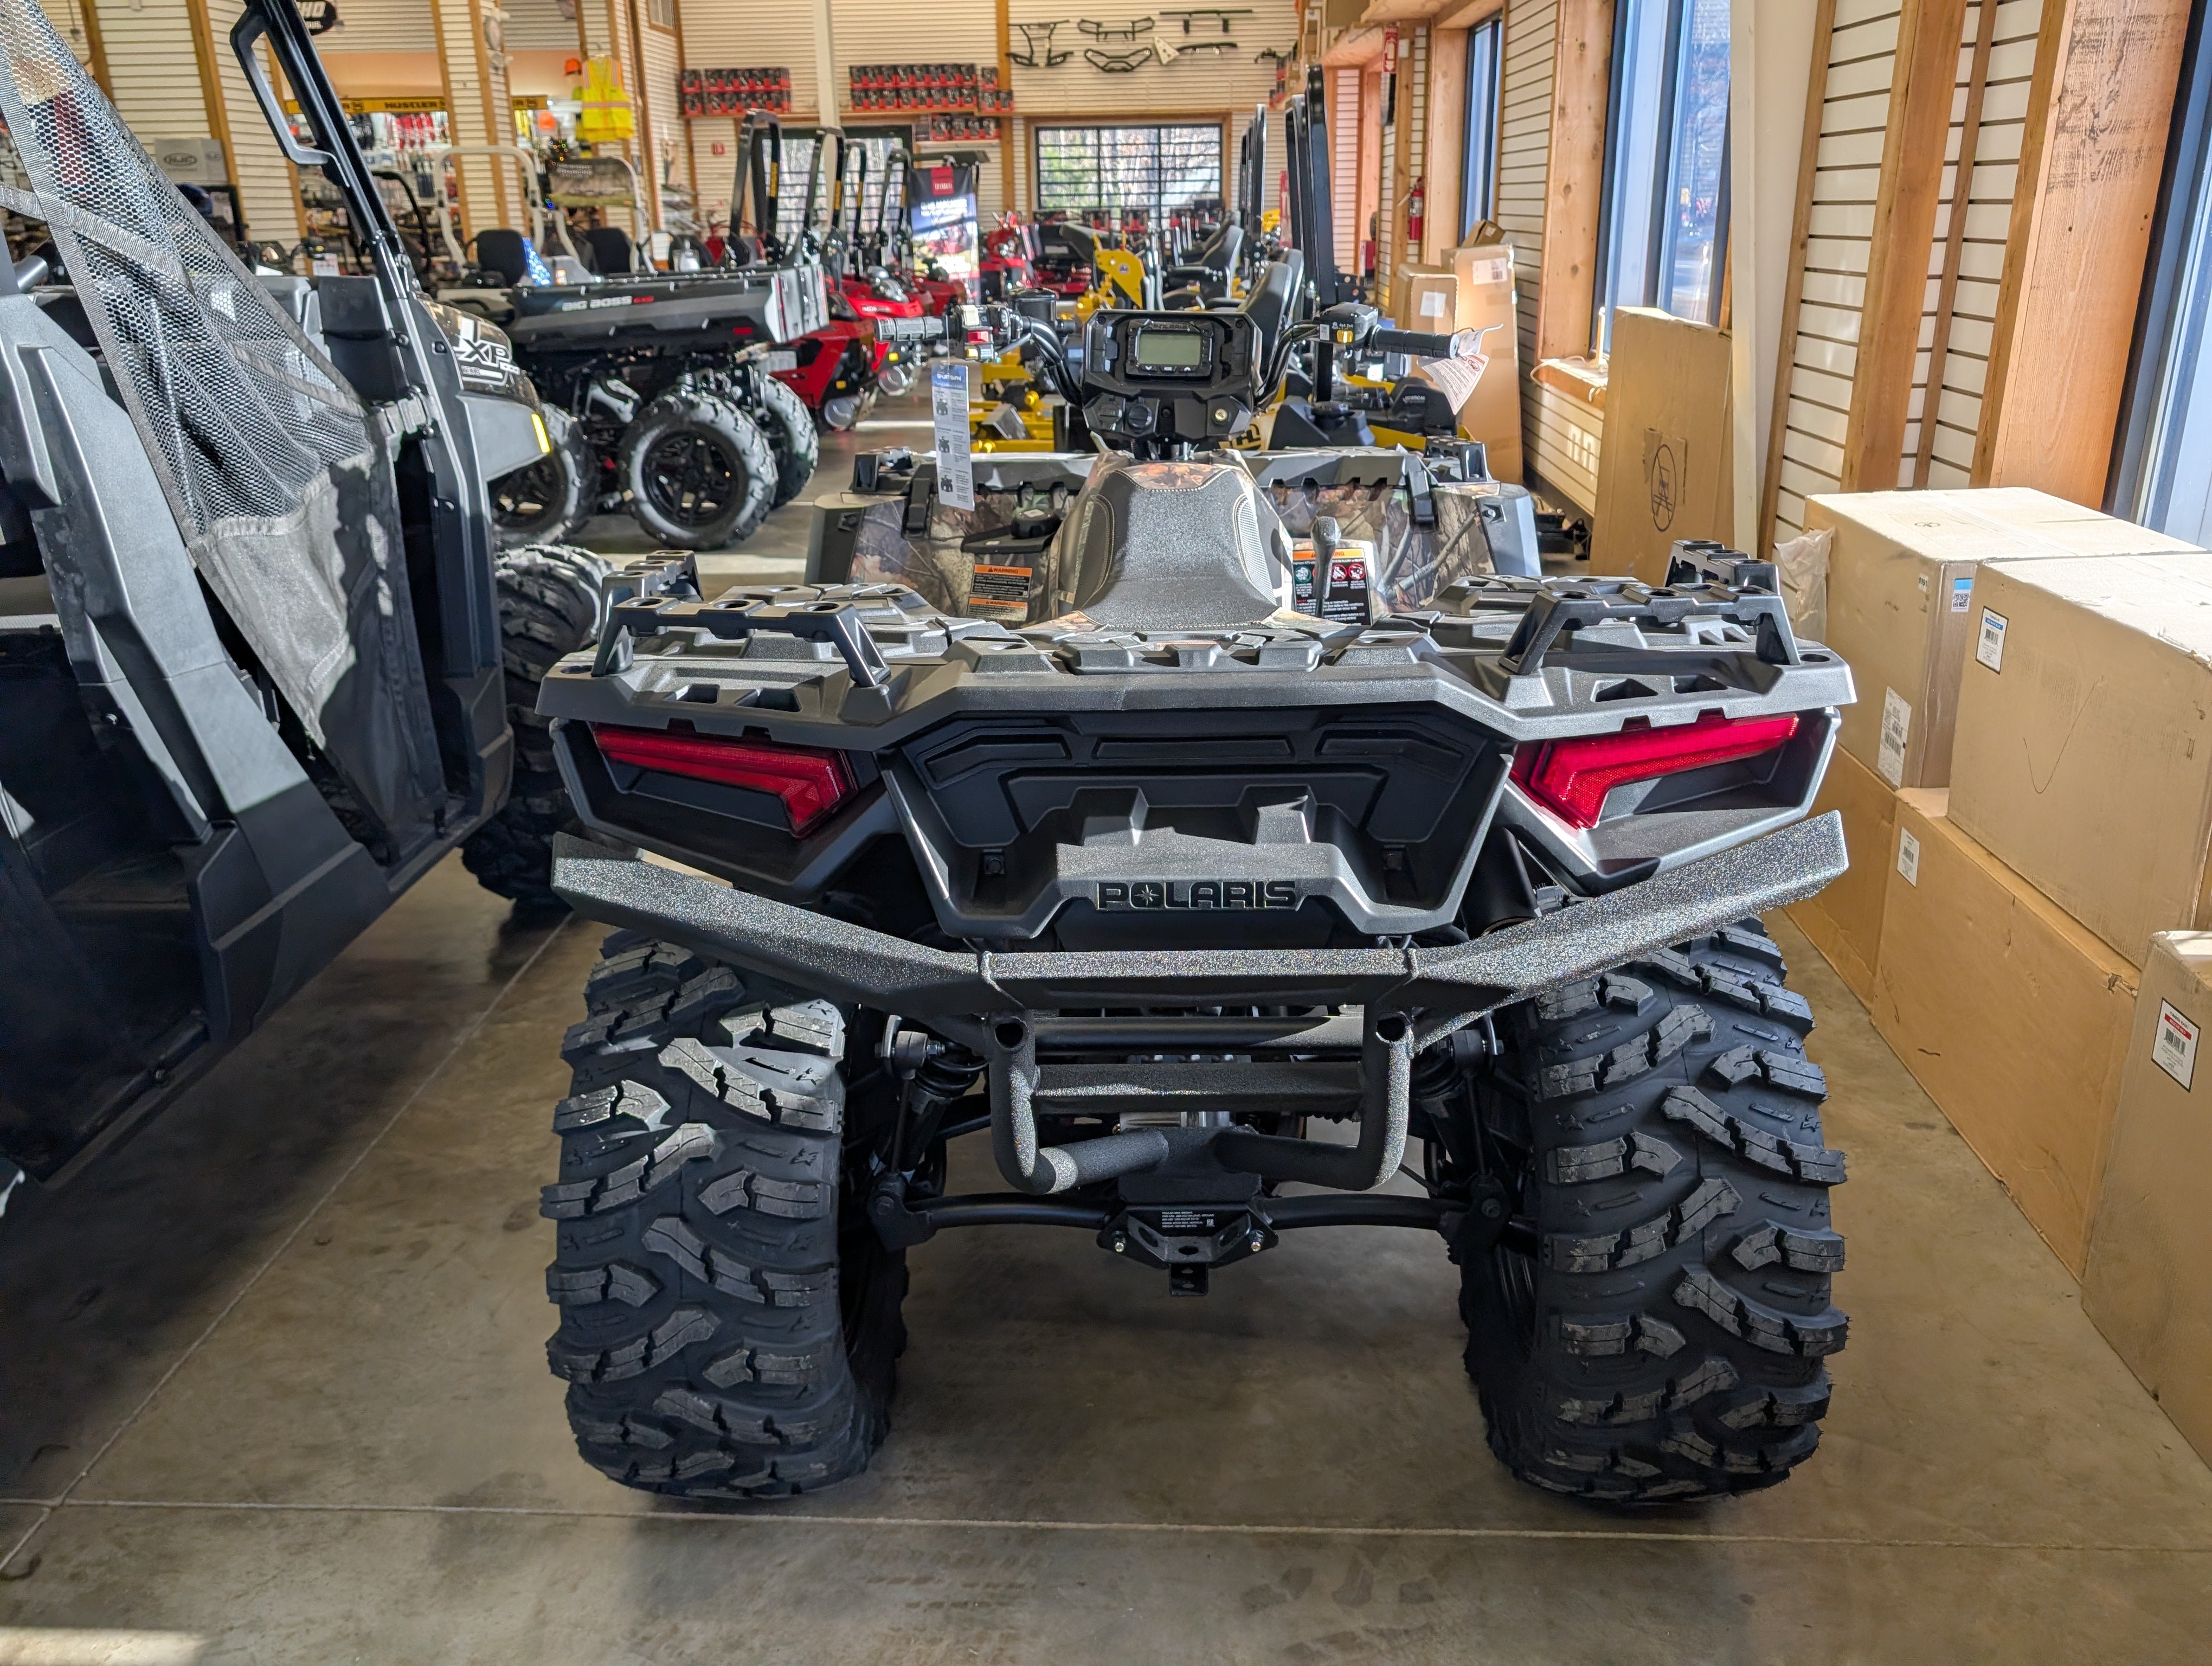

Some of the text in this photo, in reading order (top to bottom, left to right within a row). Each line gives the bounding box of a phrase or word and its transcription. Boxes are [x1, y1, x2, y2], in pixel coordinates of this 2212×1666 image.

[562, 300, 588, 311] BIG
[590, 296, 633, 309] BOSS
[1097, 881, 1297, 909] POLARIS
